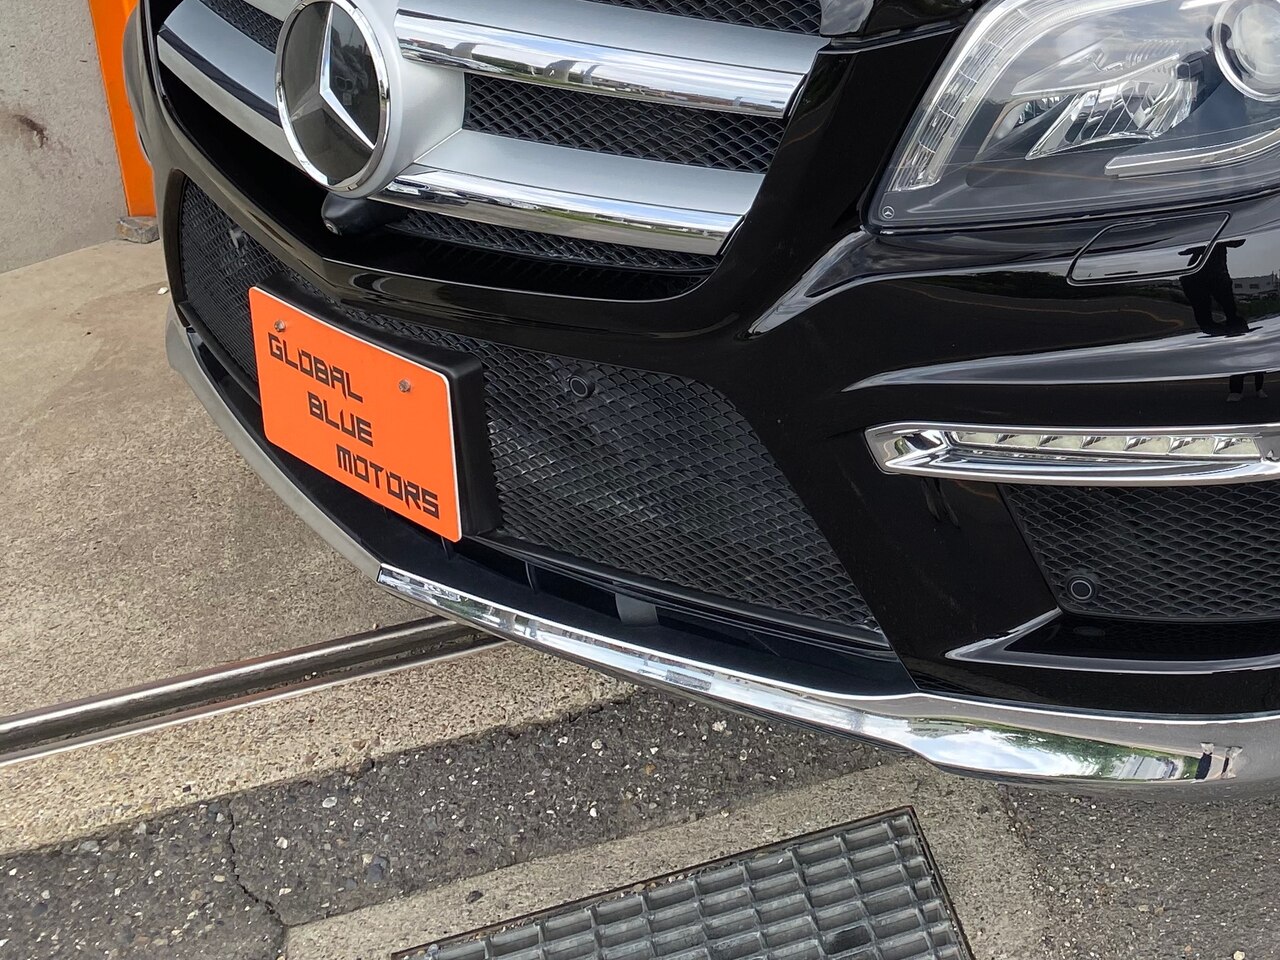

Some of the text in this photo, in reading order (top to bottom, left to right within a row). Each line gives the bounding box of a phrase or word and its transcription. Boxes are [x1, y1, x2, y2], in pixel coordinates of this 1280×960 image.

[268, 332, 363, 403] GLOBAL
[307, 391, 373, 447] BLUE
[336, 444, 439, 519] MOTORS
